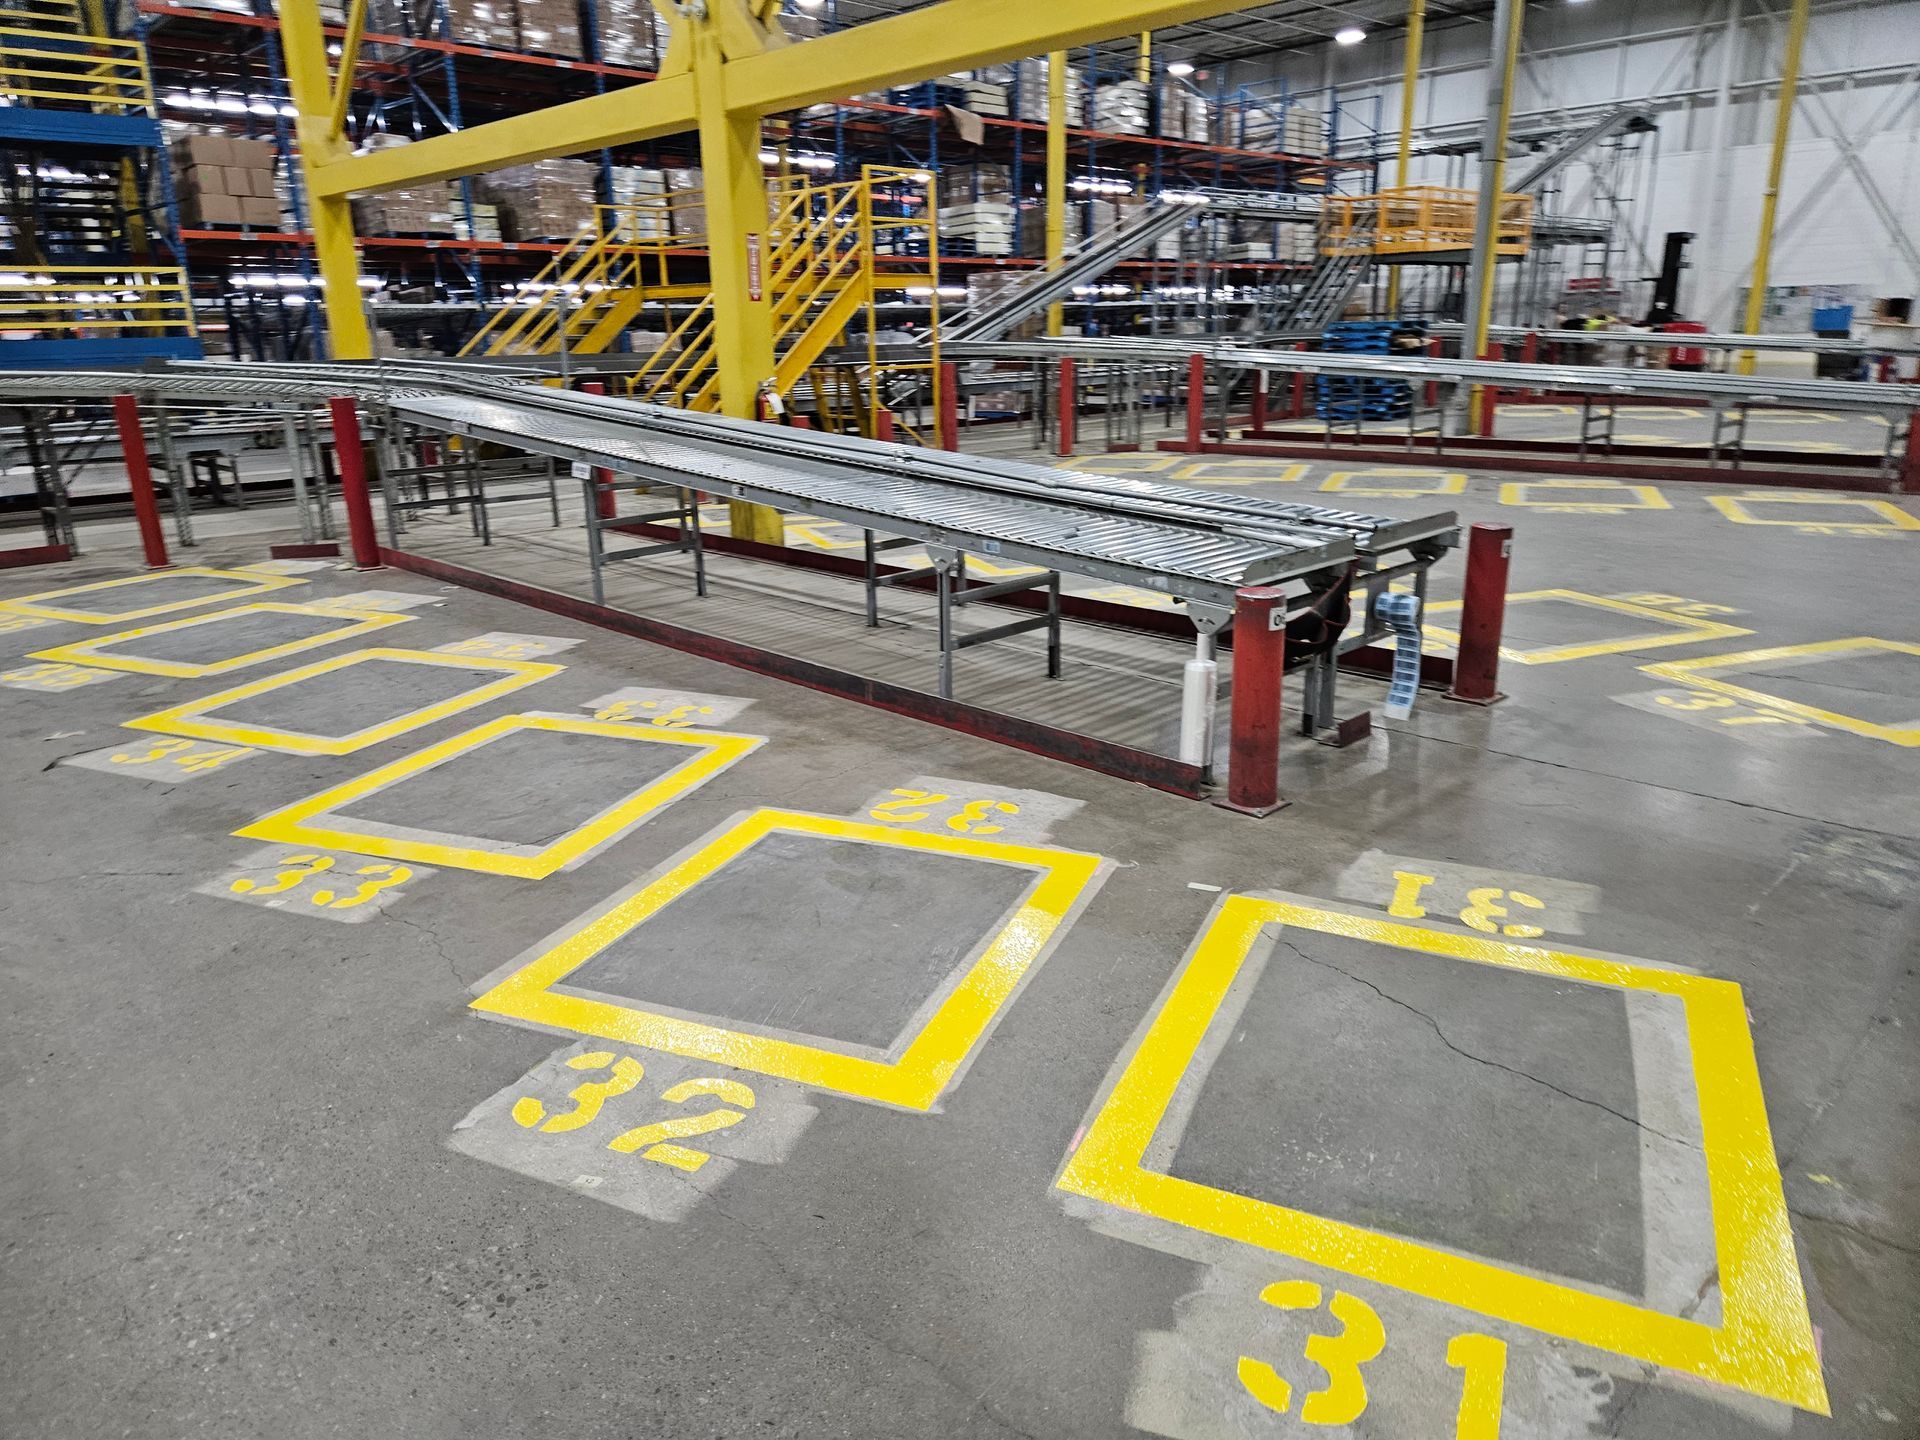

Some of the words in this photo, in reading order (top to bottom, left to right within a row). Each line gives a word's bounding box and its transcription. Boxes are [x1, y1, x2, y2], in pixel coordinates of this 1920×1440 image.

[594, 701, 714, 728] 33
[1654, 691, 1810, 725] 37
[110, 738, 255, 774] 34
[869, 788, 1020, 835] 32
[230, 854, 413, 909] 33
[1387, 870, 1546, 938] 31
[511, 1050, 756, 1172] 32
[1237, 1279, 1508, 1440] 31
